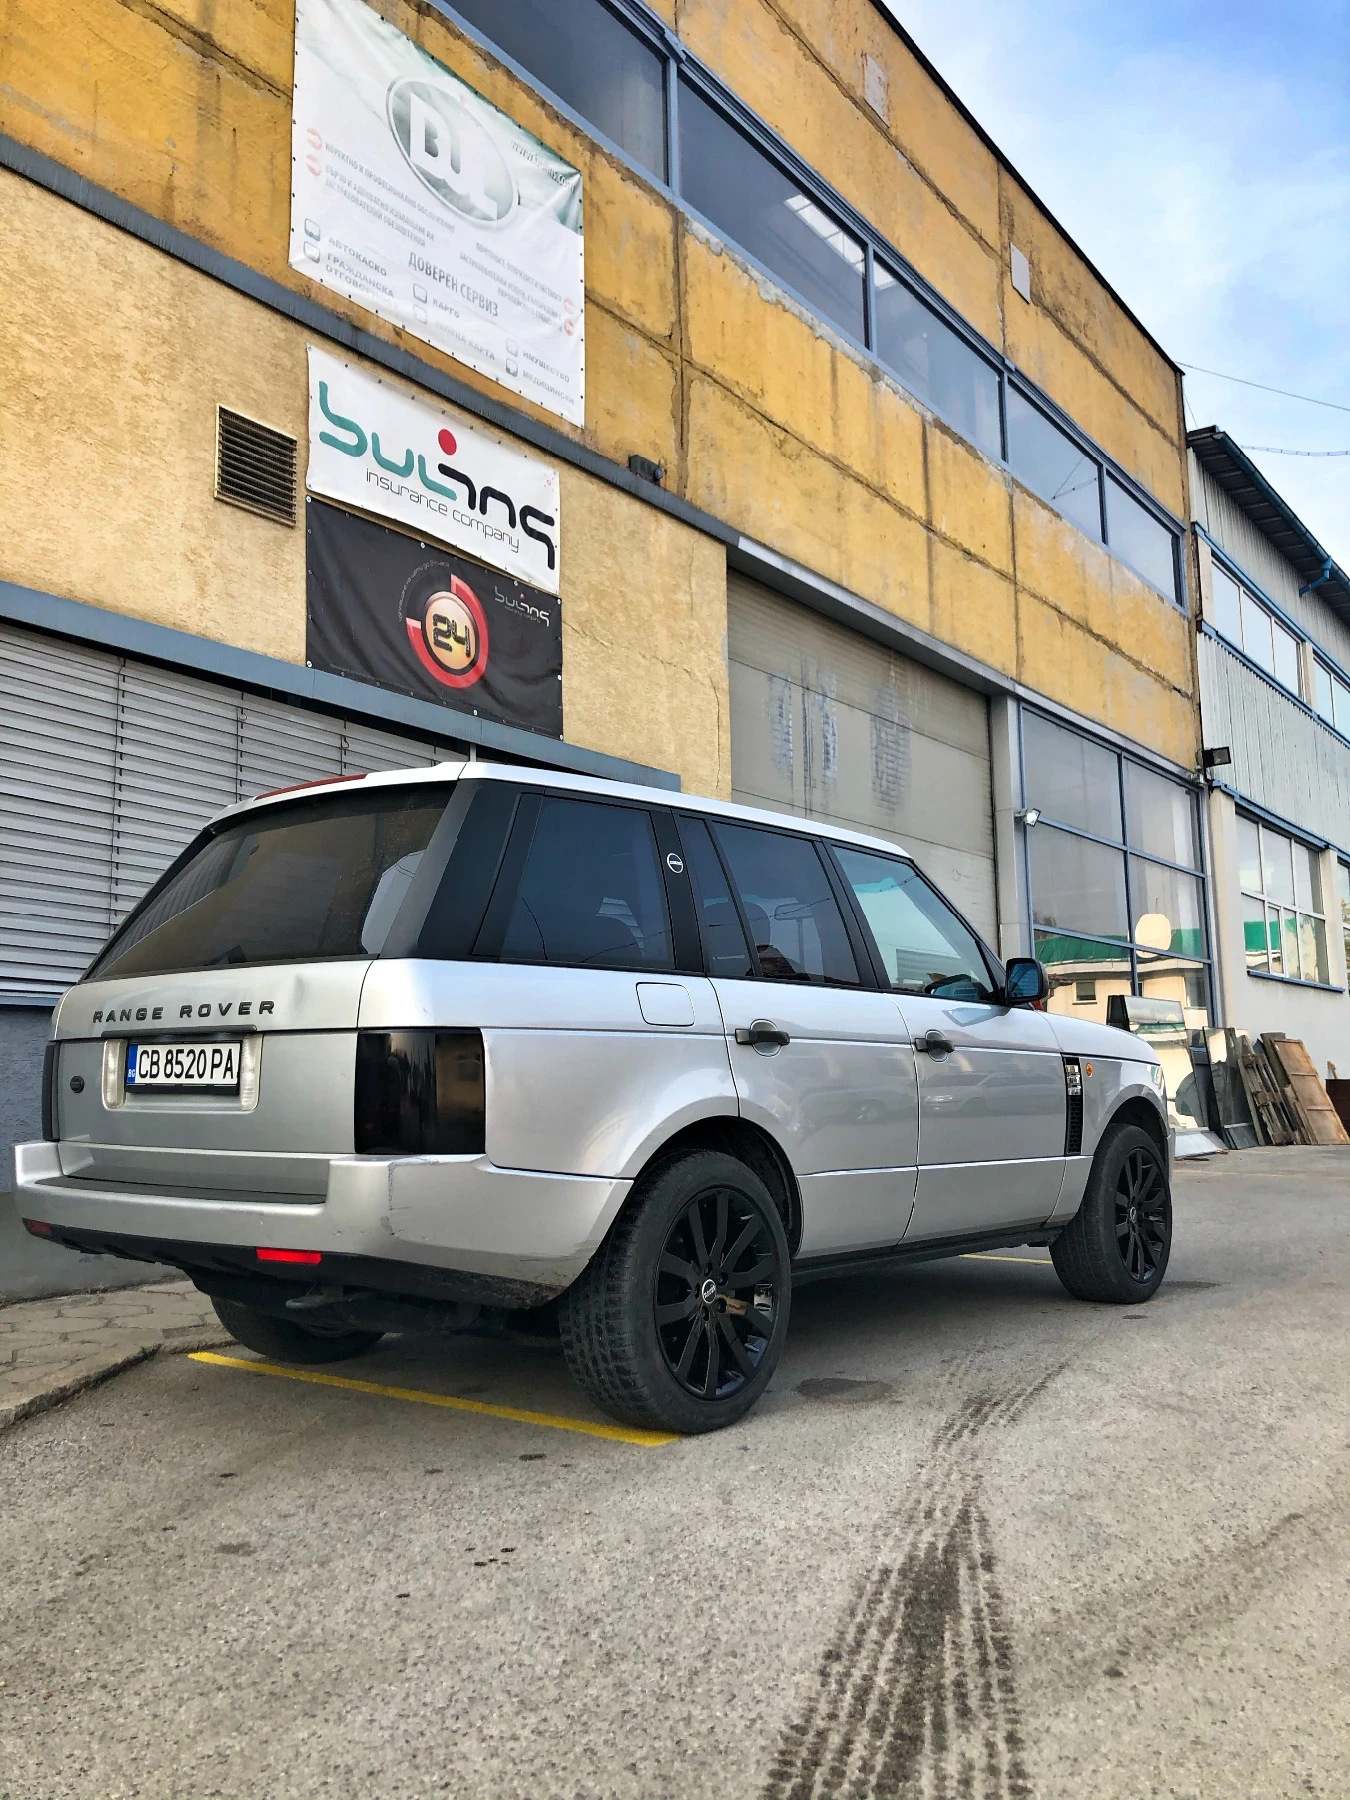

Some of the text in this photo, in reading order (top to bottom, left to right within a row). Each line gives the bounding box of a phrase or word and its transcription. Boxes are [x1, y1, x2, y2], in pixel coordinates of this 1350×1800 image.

[327, 253, 394, 298] ГРАЖДАНСКА
[328, 236, 387, 276] АВТОКАСКО
[408, 251, 458, 293] ДОВЕРЕН
[460, 283, 498, 317] СЕРВИЗ
[432, 297, 460, 319] КАРГО
[366, 468, 520, 553] insurance company
[432, 613, 471, 658] 24
[92, 1000, 275, 1023] RANGE ROVER
[127, 1068, 136, 1078] BG
